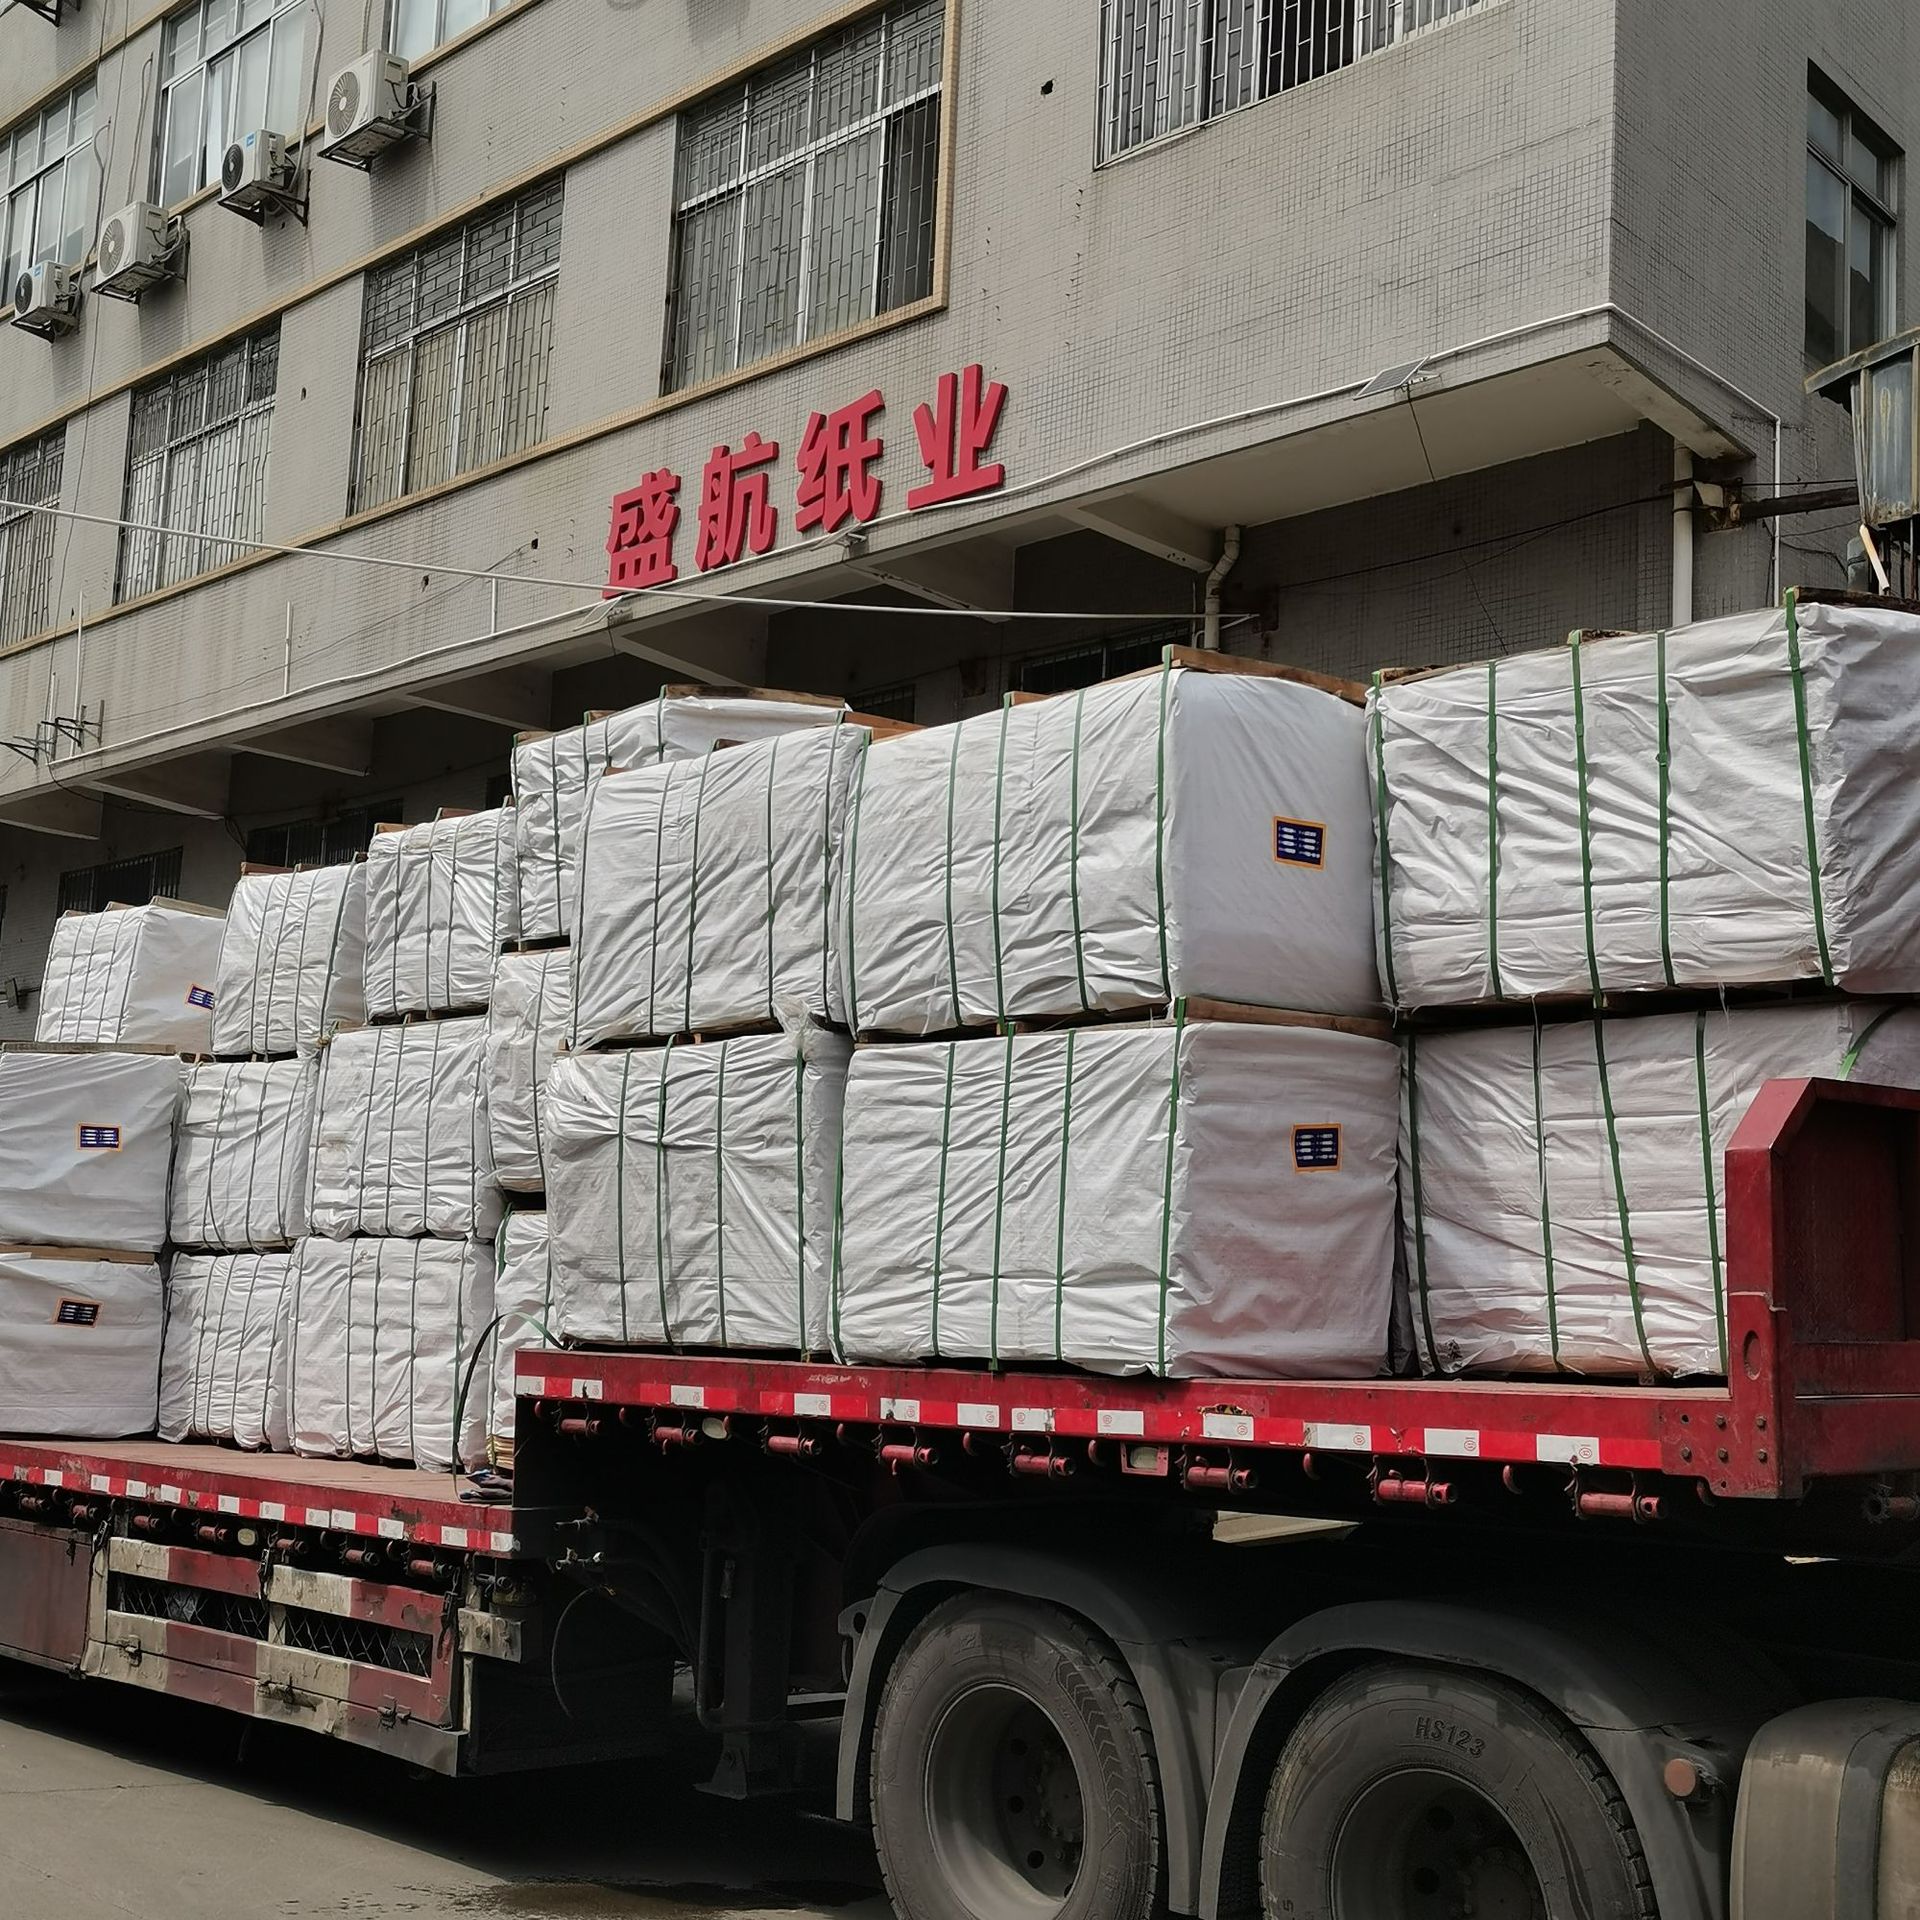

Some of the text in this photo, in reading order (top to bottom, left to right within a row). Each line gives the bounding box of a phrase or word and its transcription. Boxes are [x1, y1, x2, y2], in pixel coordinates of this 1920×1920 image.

[602, 363, 1008, 599] 盛航纸业
[1414, 1715, 1486, 1757] HS123
